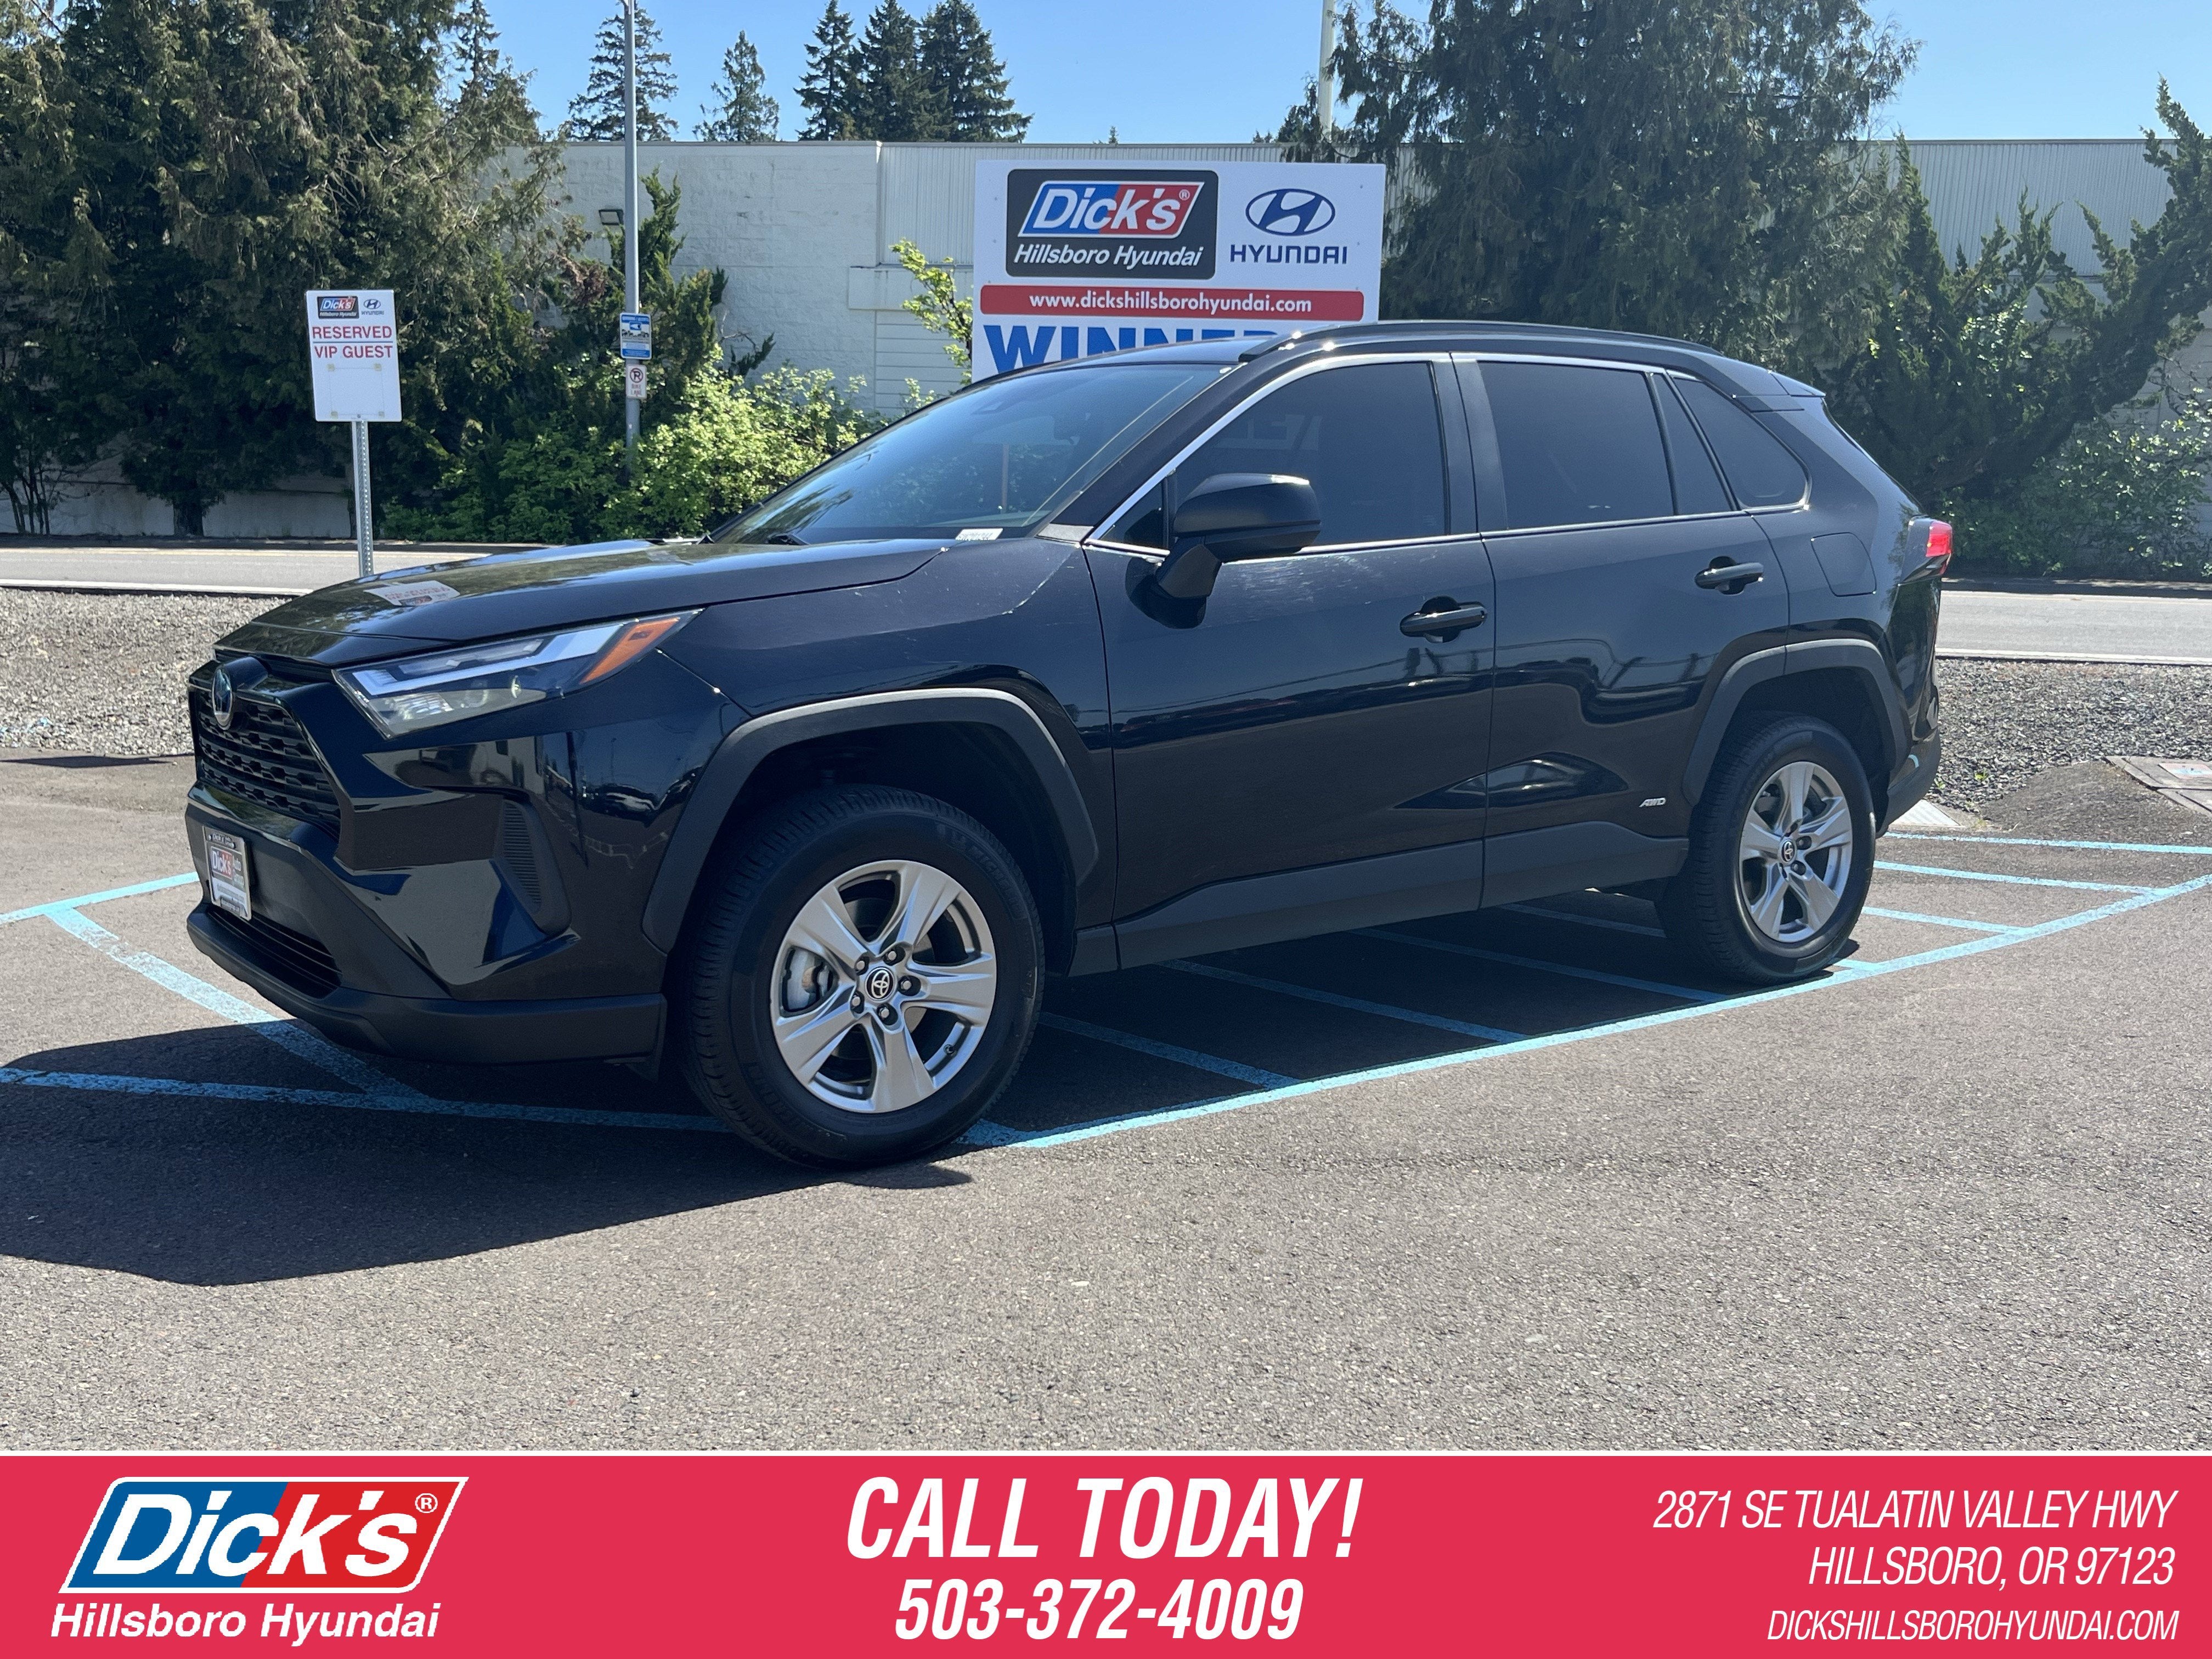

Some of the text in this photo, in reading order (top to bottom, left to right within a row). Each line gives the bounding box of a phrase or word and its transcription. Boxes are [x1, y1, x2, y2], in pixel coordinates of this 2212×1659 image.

[1013, 243, 1204, 270] Hillsboro Hyundai
[1229, 244, 1347, 264] HYUNDAI
[1029, 291, 1312, 315] www.dickshillsborohyundai.com
[312, 326, 392, 339] RESERVED
[314, 346, 393, 358] VIP GUEST
[1639, 797, 1666, 808] AWD
